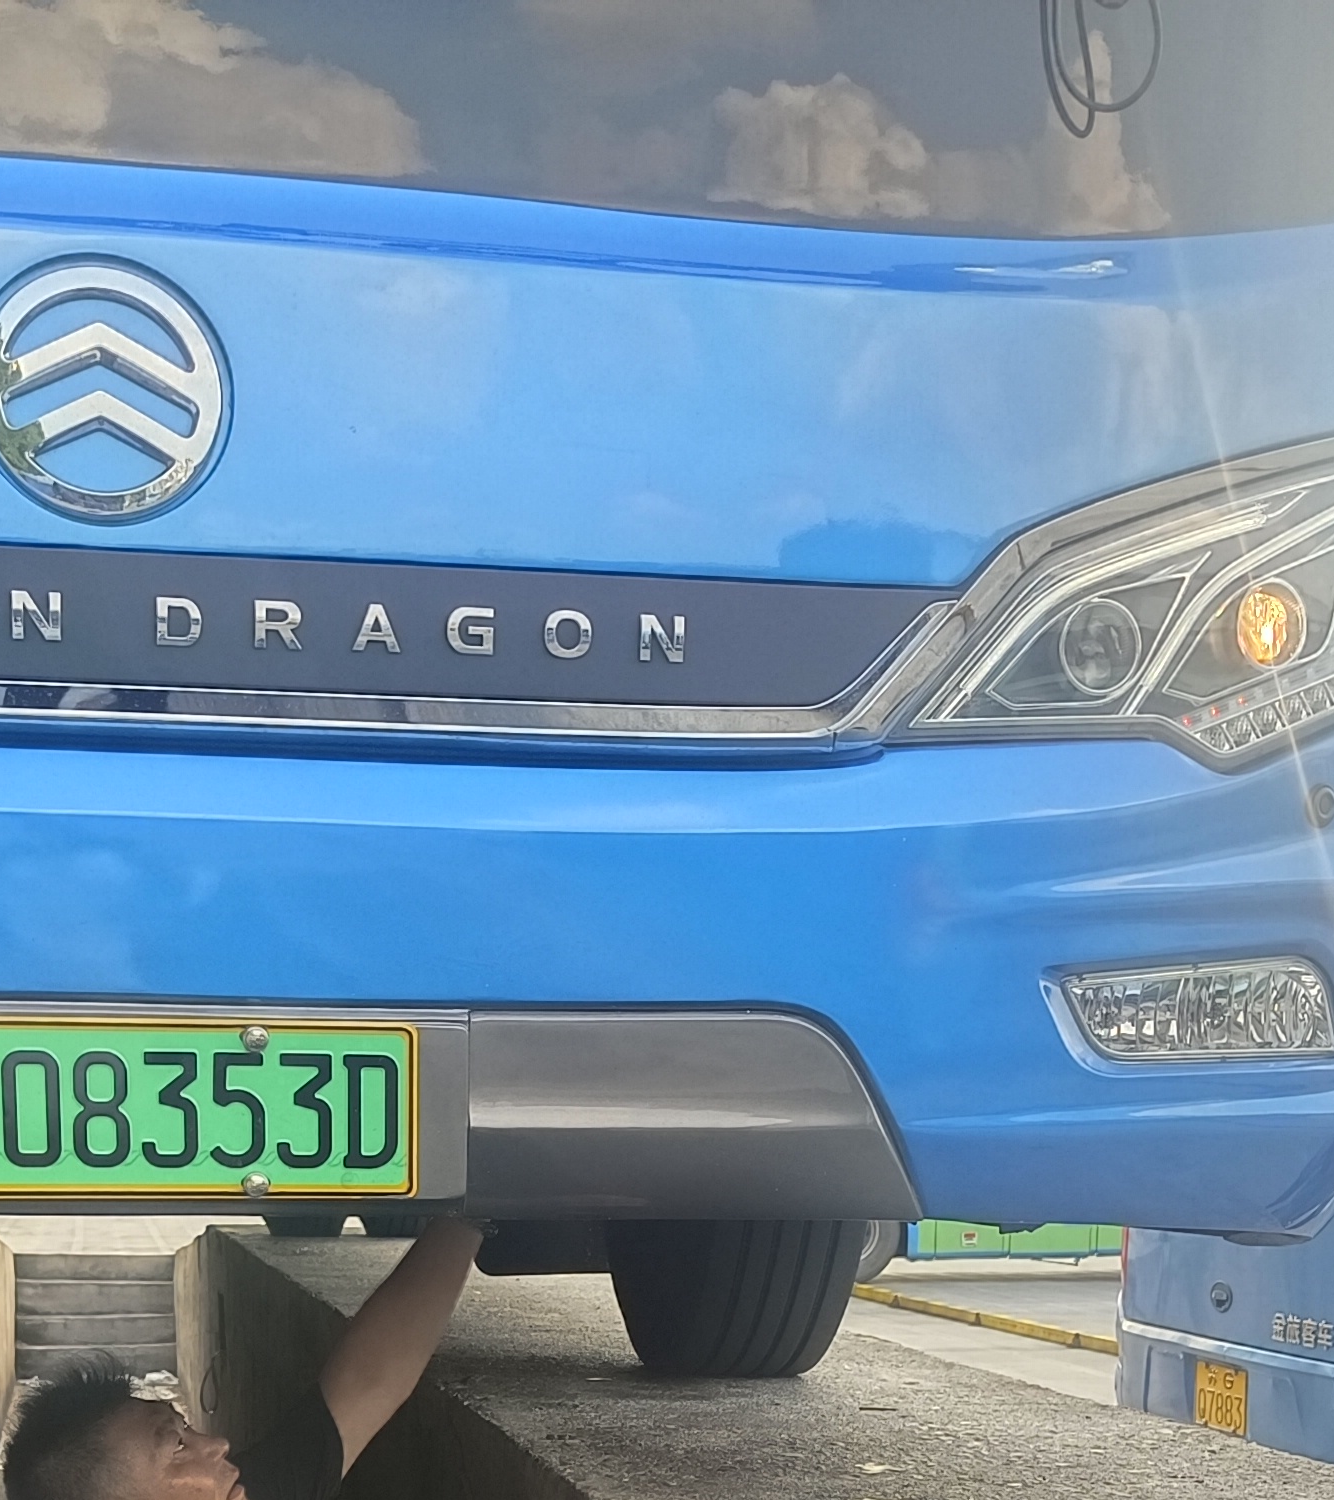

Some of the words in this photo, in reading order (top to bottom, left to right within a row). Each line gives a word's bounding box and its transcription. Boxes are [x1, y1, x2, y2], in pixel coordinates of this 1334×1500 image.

[155, 596, 687, 663] DRAGON
[0, 1049, 399, 1169] 08353D
[1271, 1312, 1334, 1351] 金旅客车
